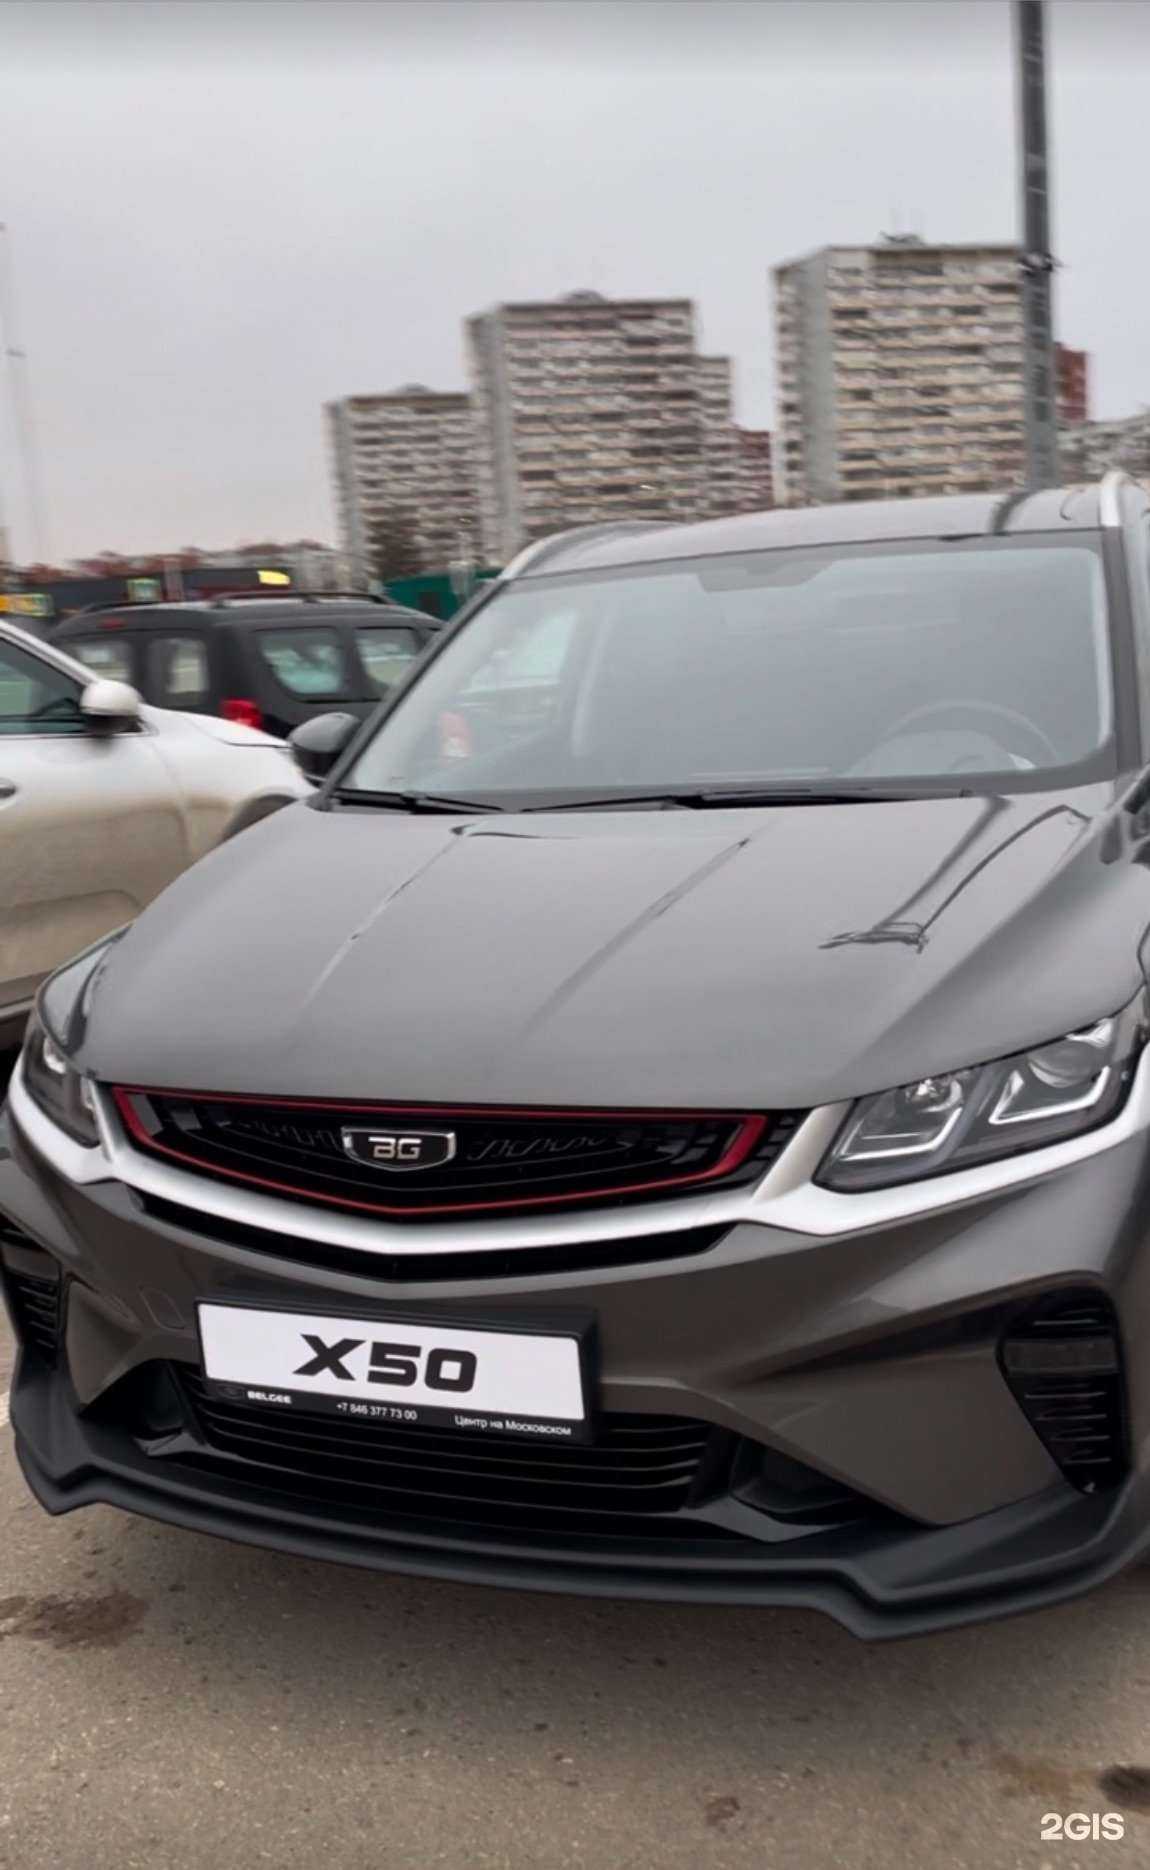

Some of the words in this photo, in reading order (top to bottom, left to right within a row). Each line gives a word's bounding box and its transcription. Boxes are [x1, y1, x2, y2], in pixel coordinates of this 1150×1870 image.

[292, 1334, 478, 1393] X50
[247, 1390, 292, 1404] BELGEE
[336, 1402, 348, 1411] +7
[369, 1406, 387, 1417] 377
[390, 1408, 401, 1418] 73
[404, 1409, 417, 1420] 00
[454, 1415, 488, 1429] Центр
[490, 1421, 503, 1430] на
[505, 1420, 572, 1435] Московском
